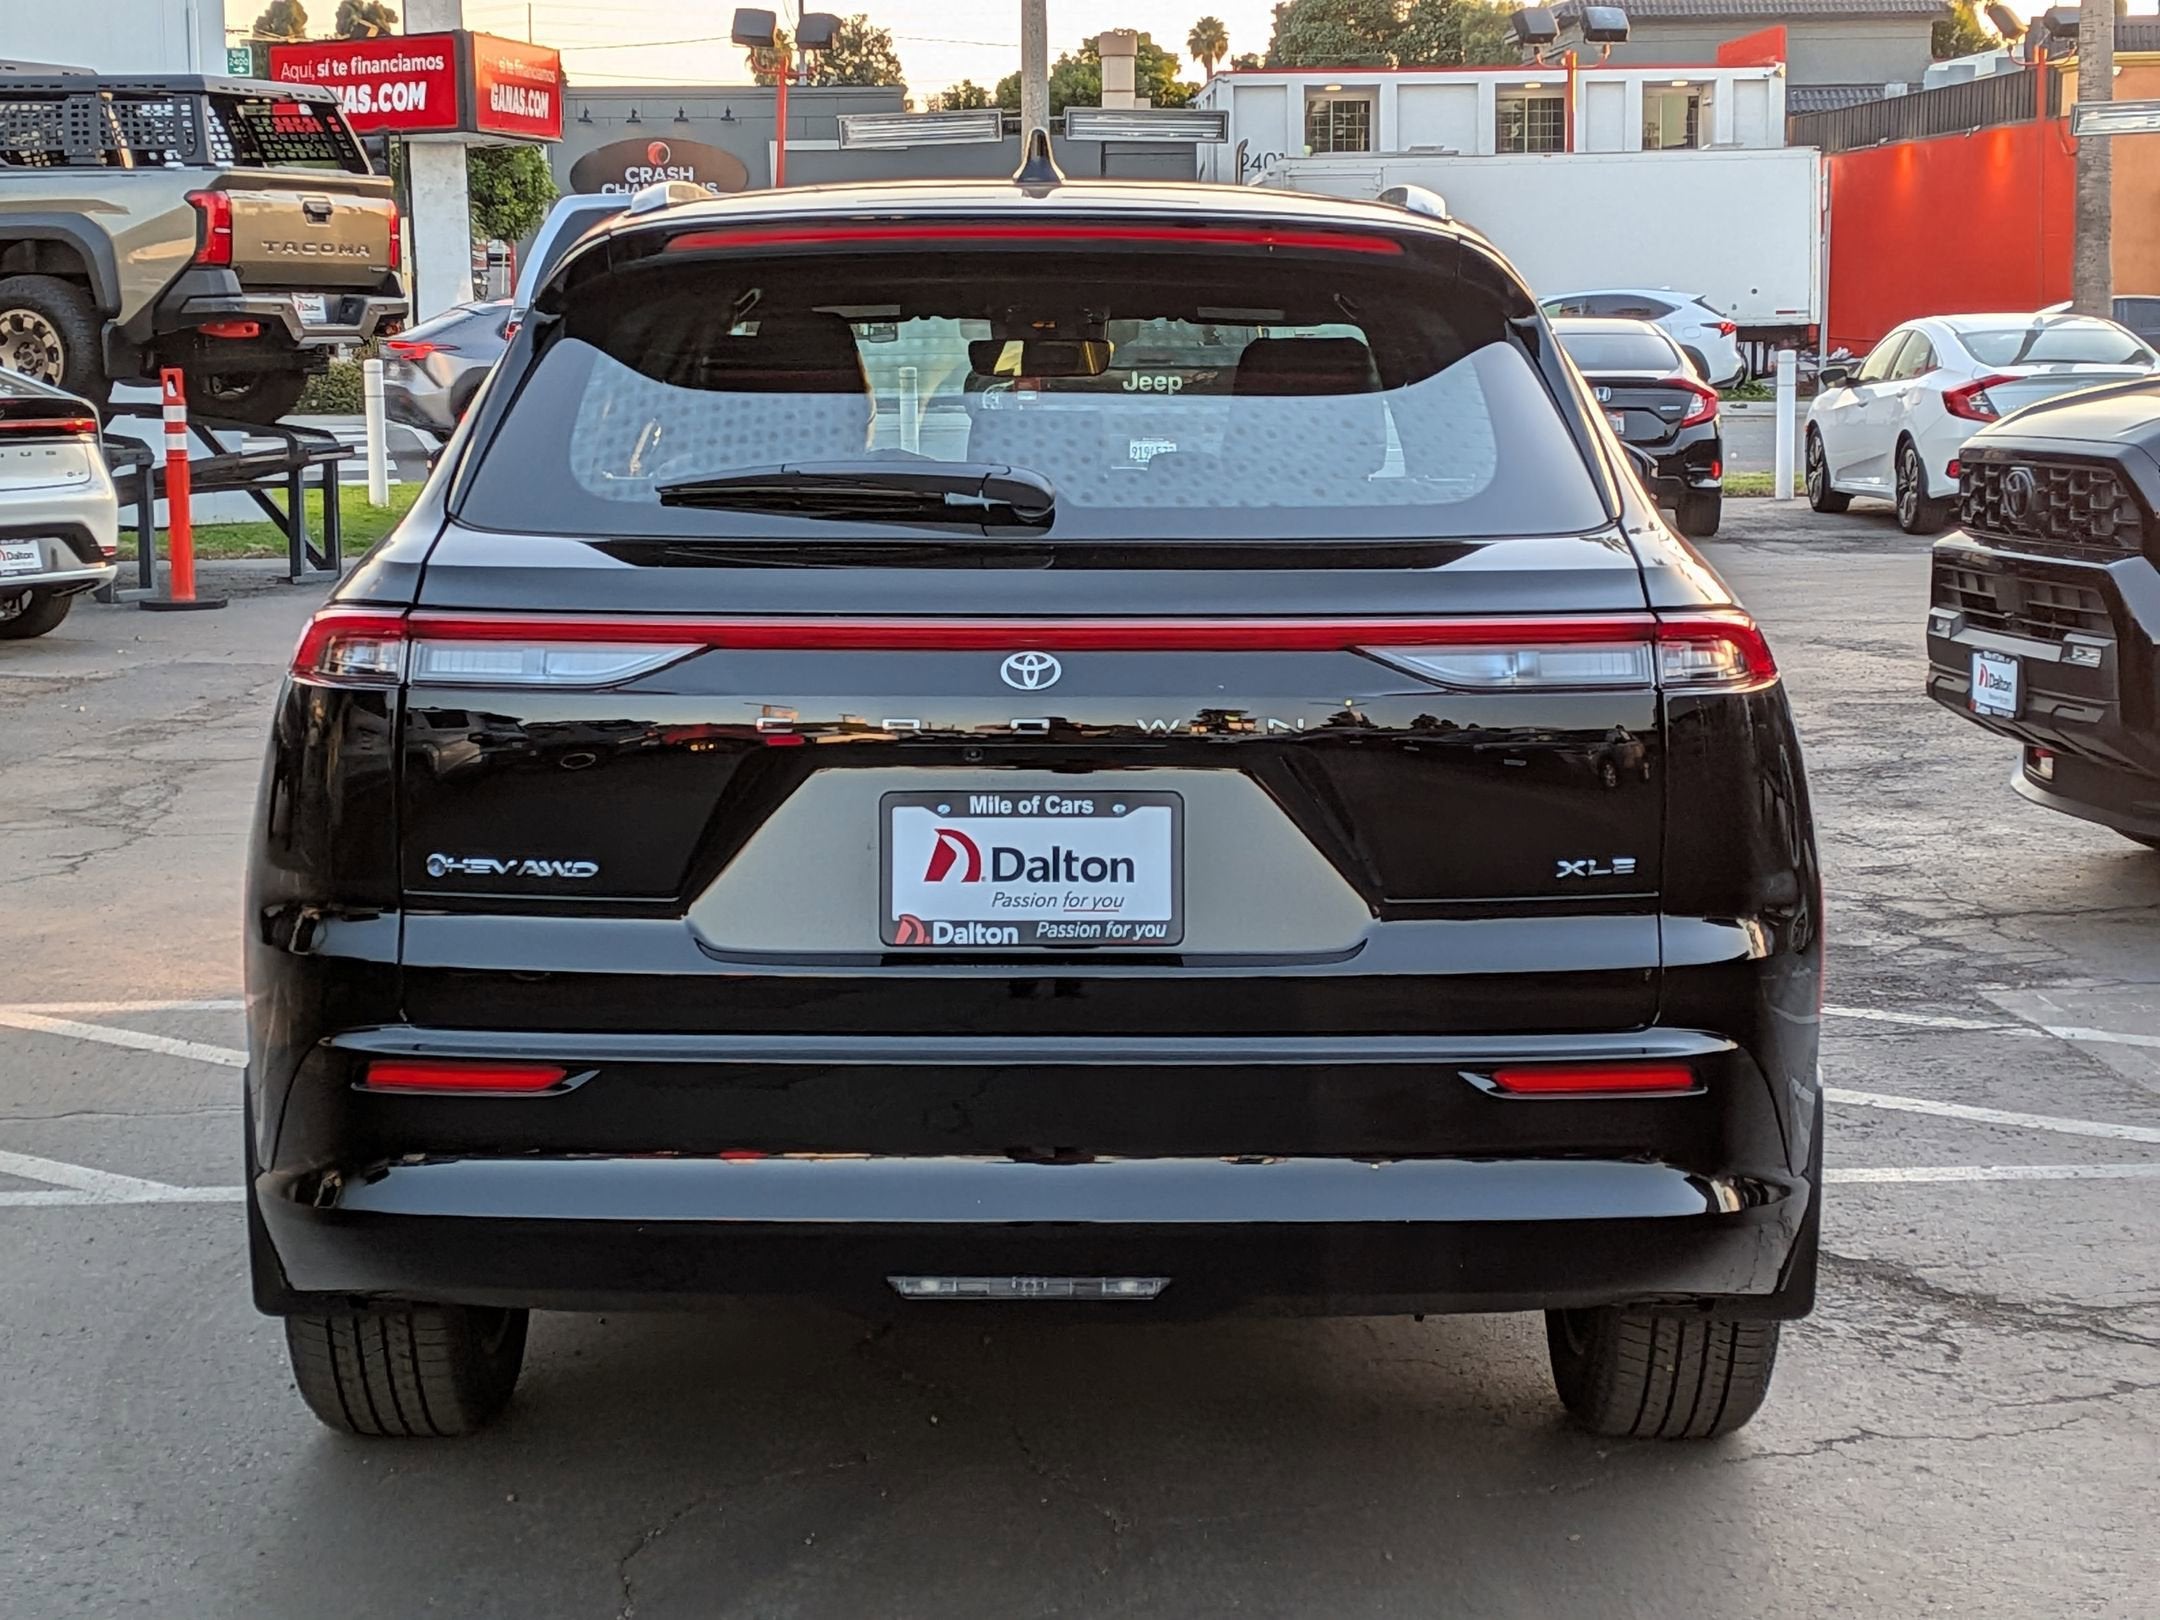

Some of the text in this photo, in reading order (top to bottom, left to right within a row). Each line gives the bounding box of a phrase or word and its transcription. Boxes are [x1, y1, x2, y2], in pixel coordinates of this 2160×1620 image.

[281, 53, 444, 82] Aquí, sí te financiamos
[625, 166, 694, 183] CRASH
[261, 240, 370, 257] TACOMA
[1122, 371, 1183, 395] Jeep
[969, 795, 1094, 815] Mile of Cars
[516, 860, 599, 878] AWD
[991, 846, 1135, 883] Dalton
[1556, 858, 1636, 878] XLE
[991, 891, 1125, 911] Passion for you
[933, 922, 1019, 944] Dalton
[1036, 921, 1167, 941] Passion for you
